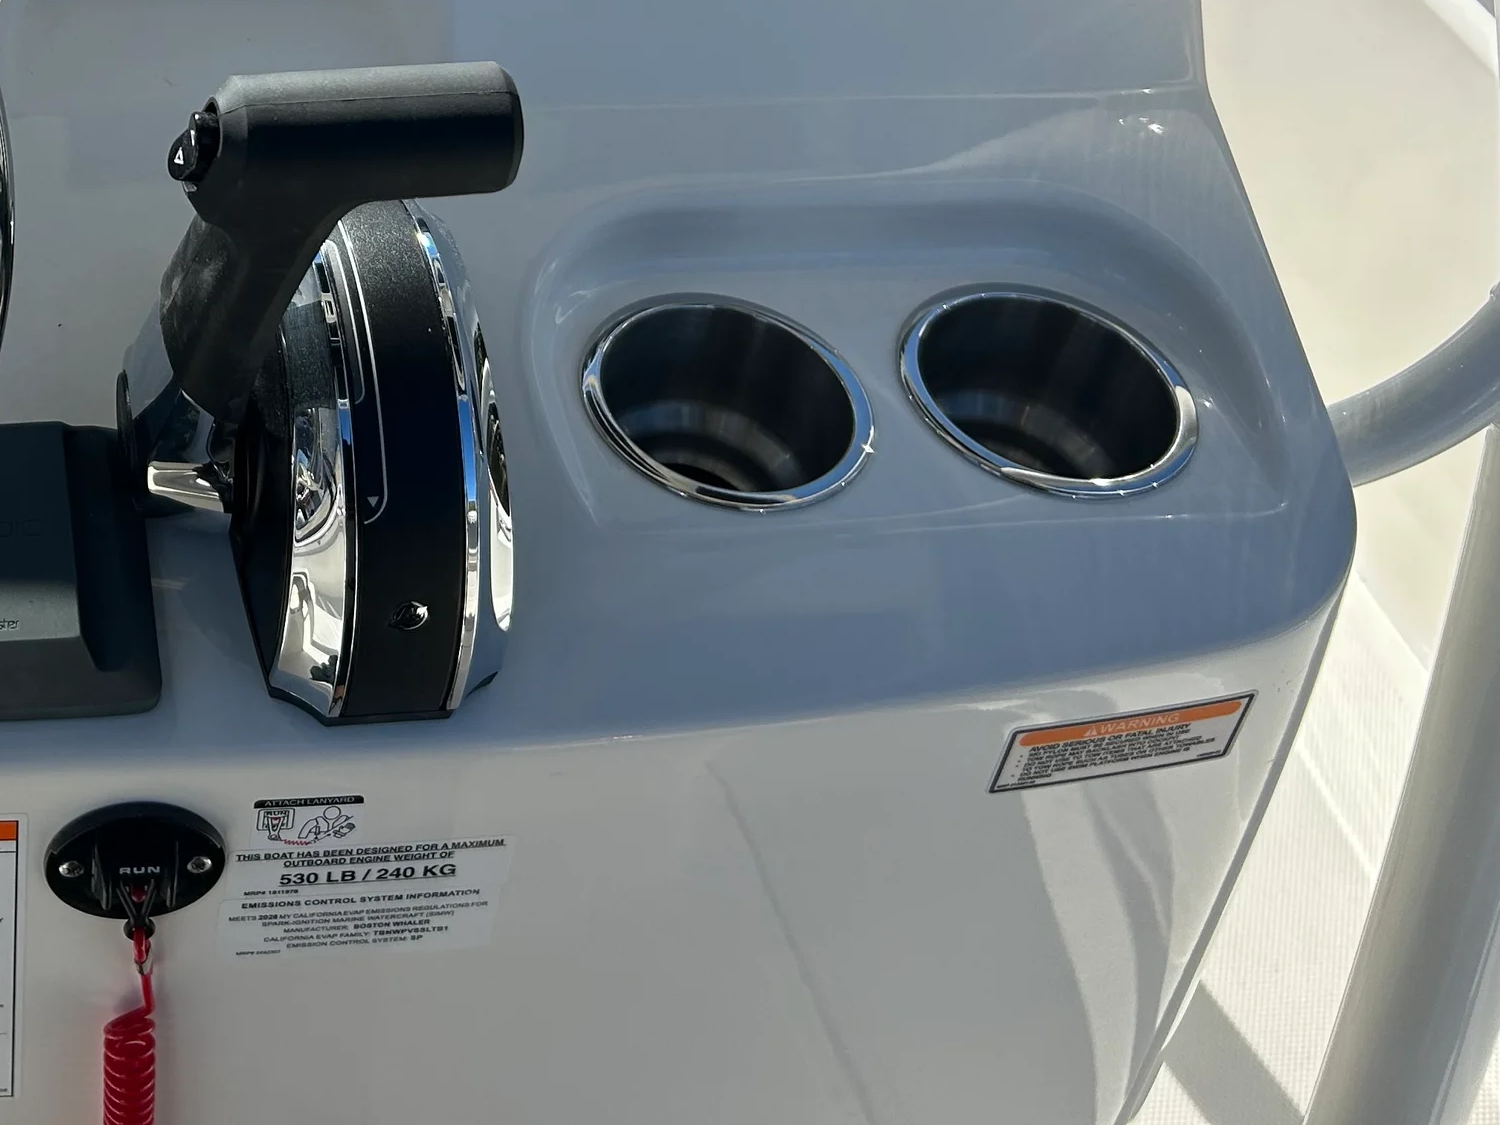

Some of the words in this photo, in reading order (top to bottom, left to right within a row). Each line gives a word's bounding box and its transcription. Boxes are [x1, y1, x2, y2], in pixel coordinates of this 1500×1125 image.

[1101, 713, 1180, 734] WARNING
[265, 798, 306, 808] ATTACH
[308, 795, 355, 805] LANYARD
[237, 852, 262, 862] THIS
[264, 851, 294, 860] BOAT
[297, 850, 320, 859] HAS
[323, 848, 354, 857] BEEN
[357, 845, 412, 855] DESIGNED
[415, 843, 438, 853] FOR
[441, 842, 449, 851] A
[452, 839, 504, 849] MAXIMUM
[283, 858, 346, 868] OUTBOARD
[350, 855, 390, 865] ENGINE
[393, 853, 438, 862] WEIGHT
[440, 850, 455, 859] OF
[120, 865, 160, 875] RUN
[281, 873, 318, 885] 530
[327, 871, 356, 882] LB
[362, 871, 371, 881] /
[376, 867, 415, 879] 240
[423, 864, 457, 876] KG
[241, 900, 301, 909] EMISSIONS
[304, 897, 356, 906] CONTROL
[360, 894, 403, 902] SYSTEM
[406, 889, 480, 899] INFORMATION
